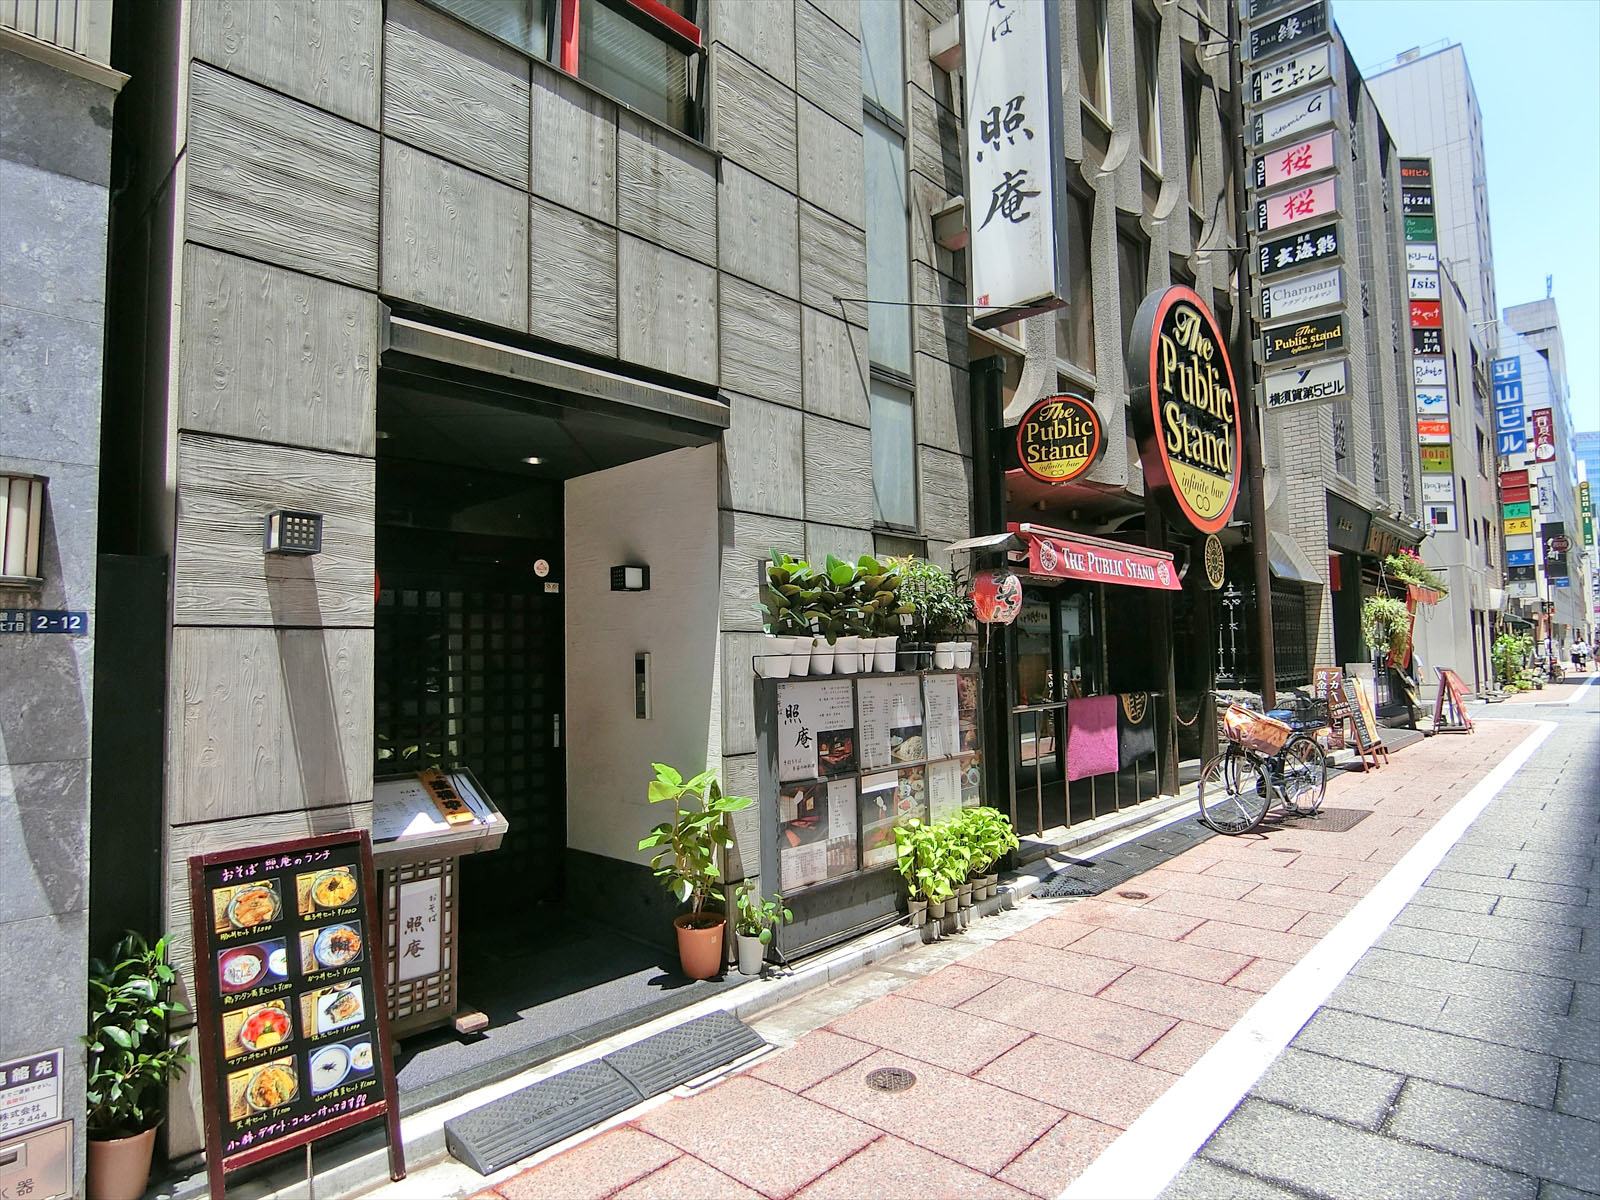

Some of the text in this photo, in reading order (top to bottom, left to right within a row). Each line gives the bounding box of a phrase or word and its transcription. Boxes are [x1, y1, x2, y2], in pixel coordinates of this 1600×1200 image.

[1271, 65, 1327, 94] こぶし
[977, 95, 1041, 232] 照庵
[1280, 144, 1313, 176] 桜
[1282, 188, 1315, 220] 桜
[1260, 247, 1270, 273] 2F
[1408, 252, 1435, 261] ドリーム
[1272, 278, 1337, 301] Charmant
[1411, 278, 1436, 289] Isis
[1262, 290, 1270, 319] 2F
[1173, 305, 1214, 362] The
[1274, 325, 1341, 351] Public stand
[1295, 324, 1317, 337] The
[1161, 332, 1234, 424] Public
[1039, 402, 1076, 422] The
[1495, 360, 1524, 453] 平山ビル
[1026, 417, 1094, 443] Public
[1165, 401, 1232, 474] Stand
[1027, 436, 1089, 464] Stand
[1038, 461, 1080, 472] infinite bar
[1182, 472, 1225, 500] infinite bar
[1061, 547, 1155, 581] THE PUBLIC STAND
[36, 615, 81, 629] 2-12
[784, 704, 813, 749] 照庵
[222, 862, 259, 882] おそば
[428, 893, 438, 923] おそば
[403, 916, 425, 959] 照庵
